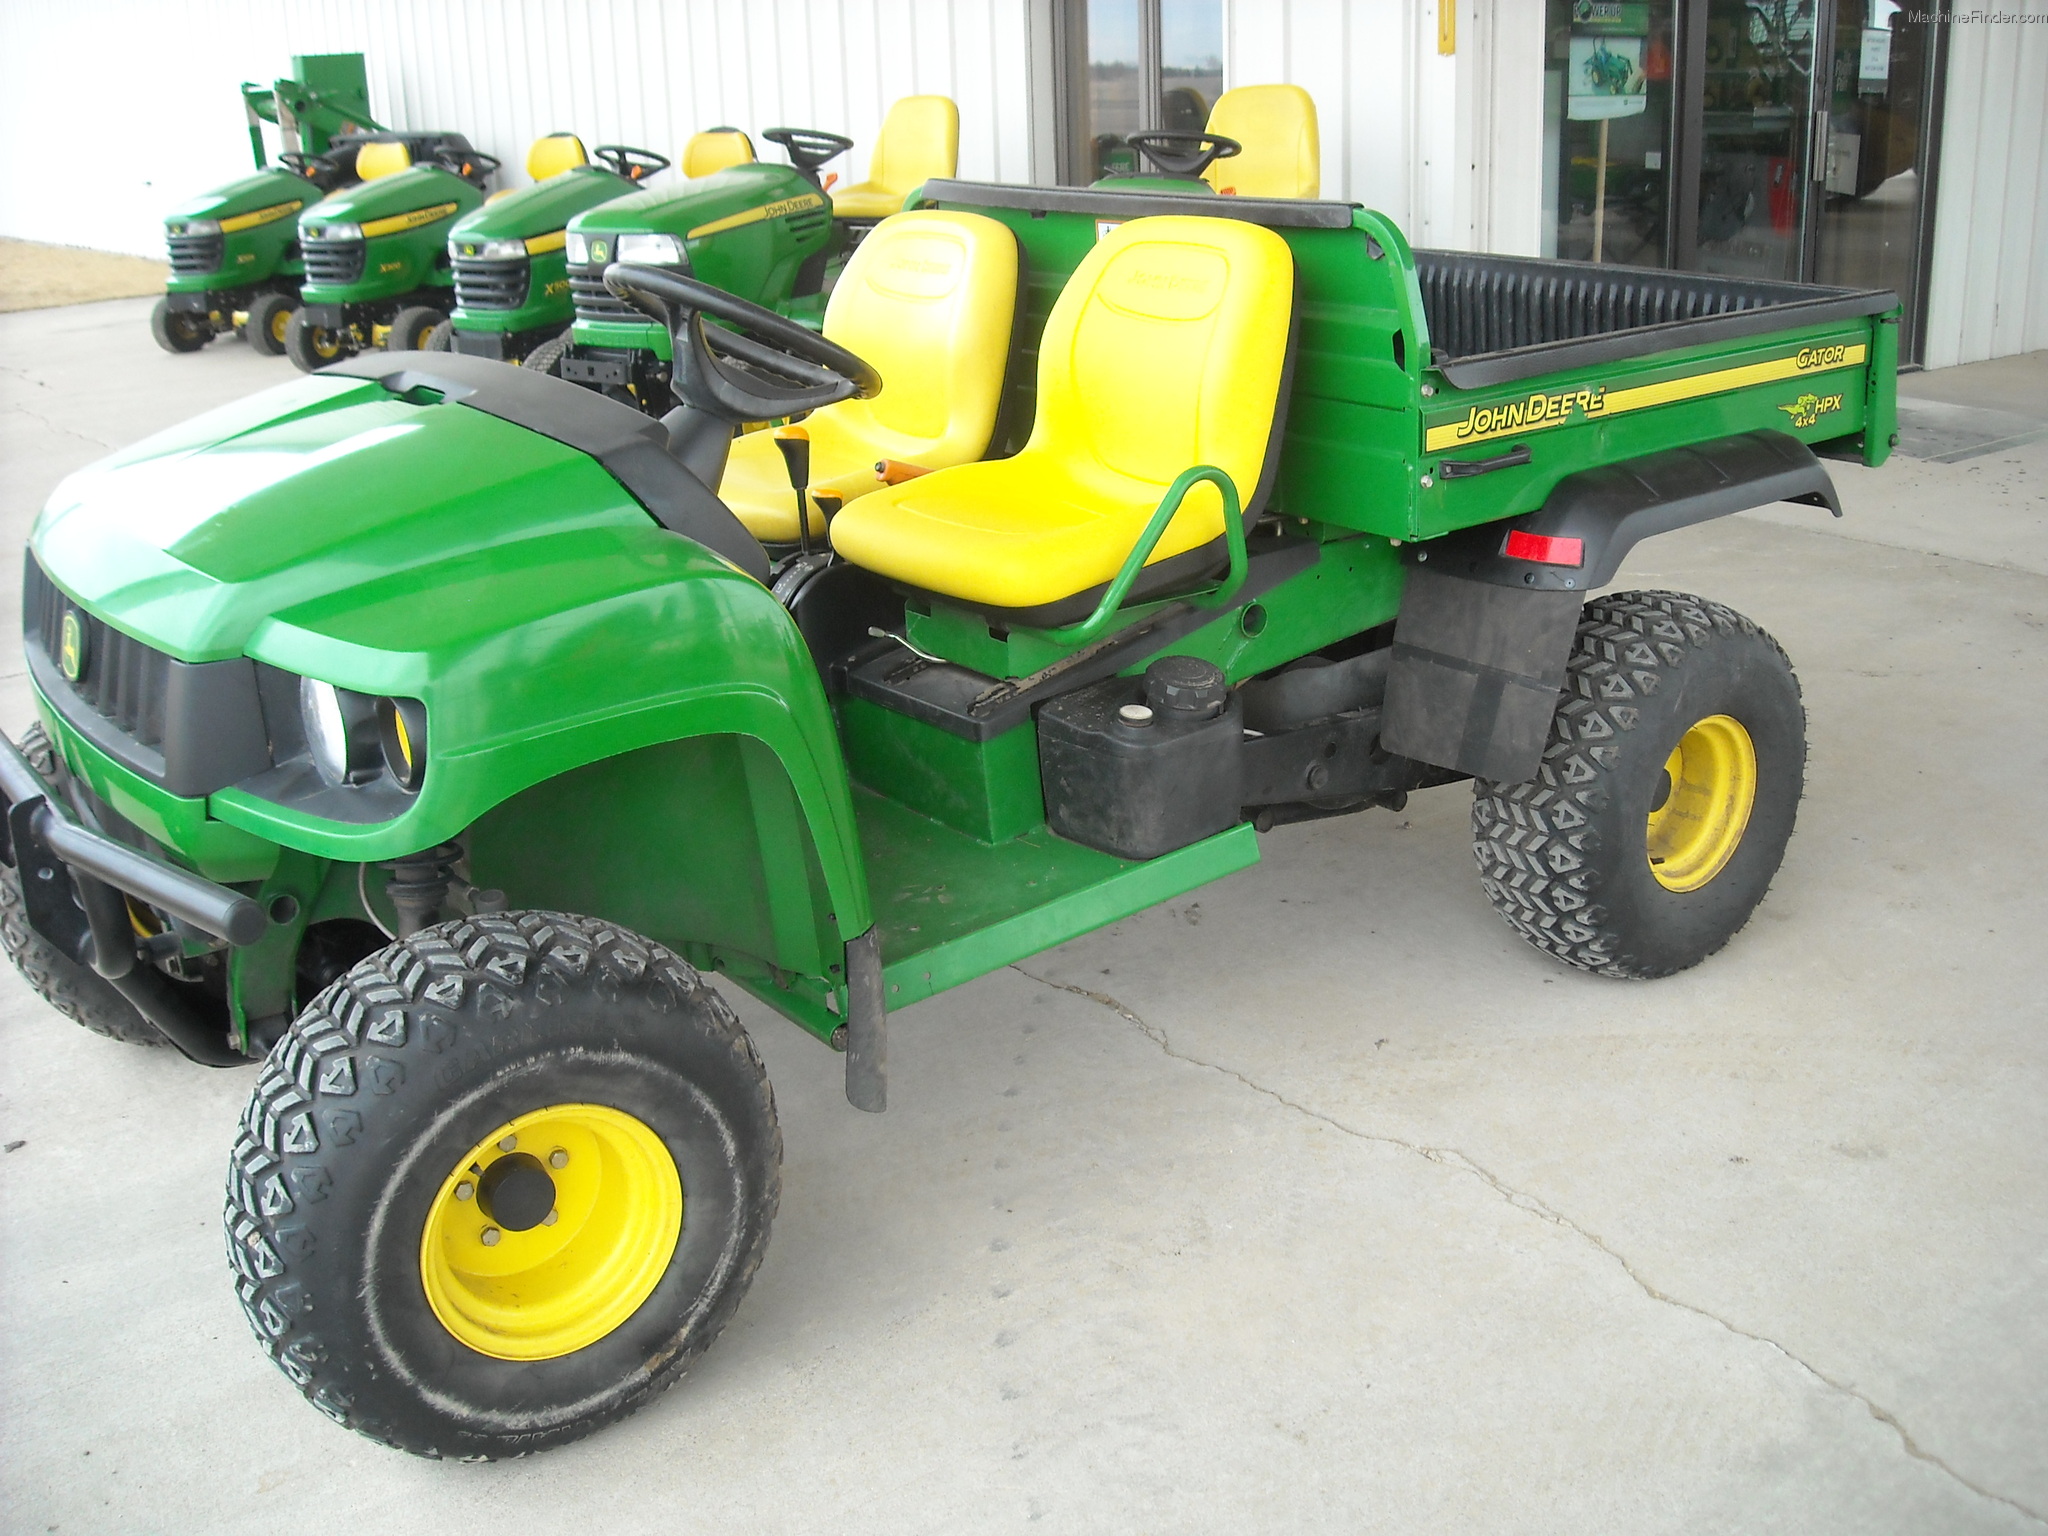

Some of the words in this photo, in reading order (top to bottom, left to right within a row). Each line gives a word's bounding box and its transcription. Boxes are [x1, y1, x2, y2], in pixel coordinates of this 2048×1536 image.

[764, 204, 788, 217] JOHN
[787, 198, 812, 211] DEERE
[1796, 345, 1845, 370] GATOR
[1457, 402, 1526, 438] JOHN
[1525, 386, 1606, 424] DEERE
[1814, 393, 1843, 415] HPX
[1794, 413, 1817, 429] 4x4
